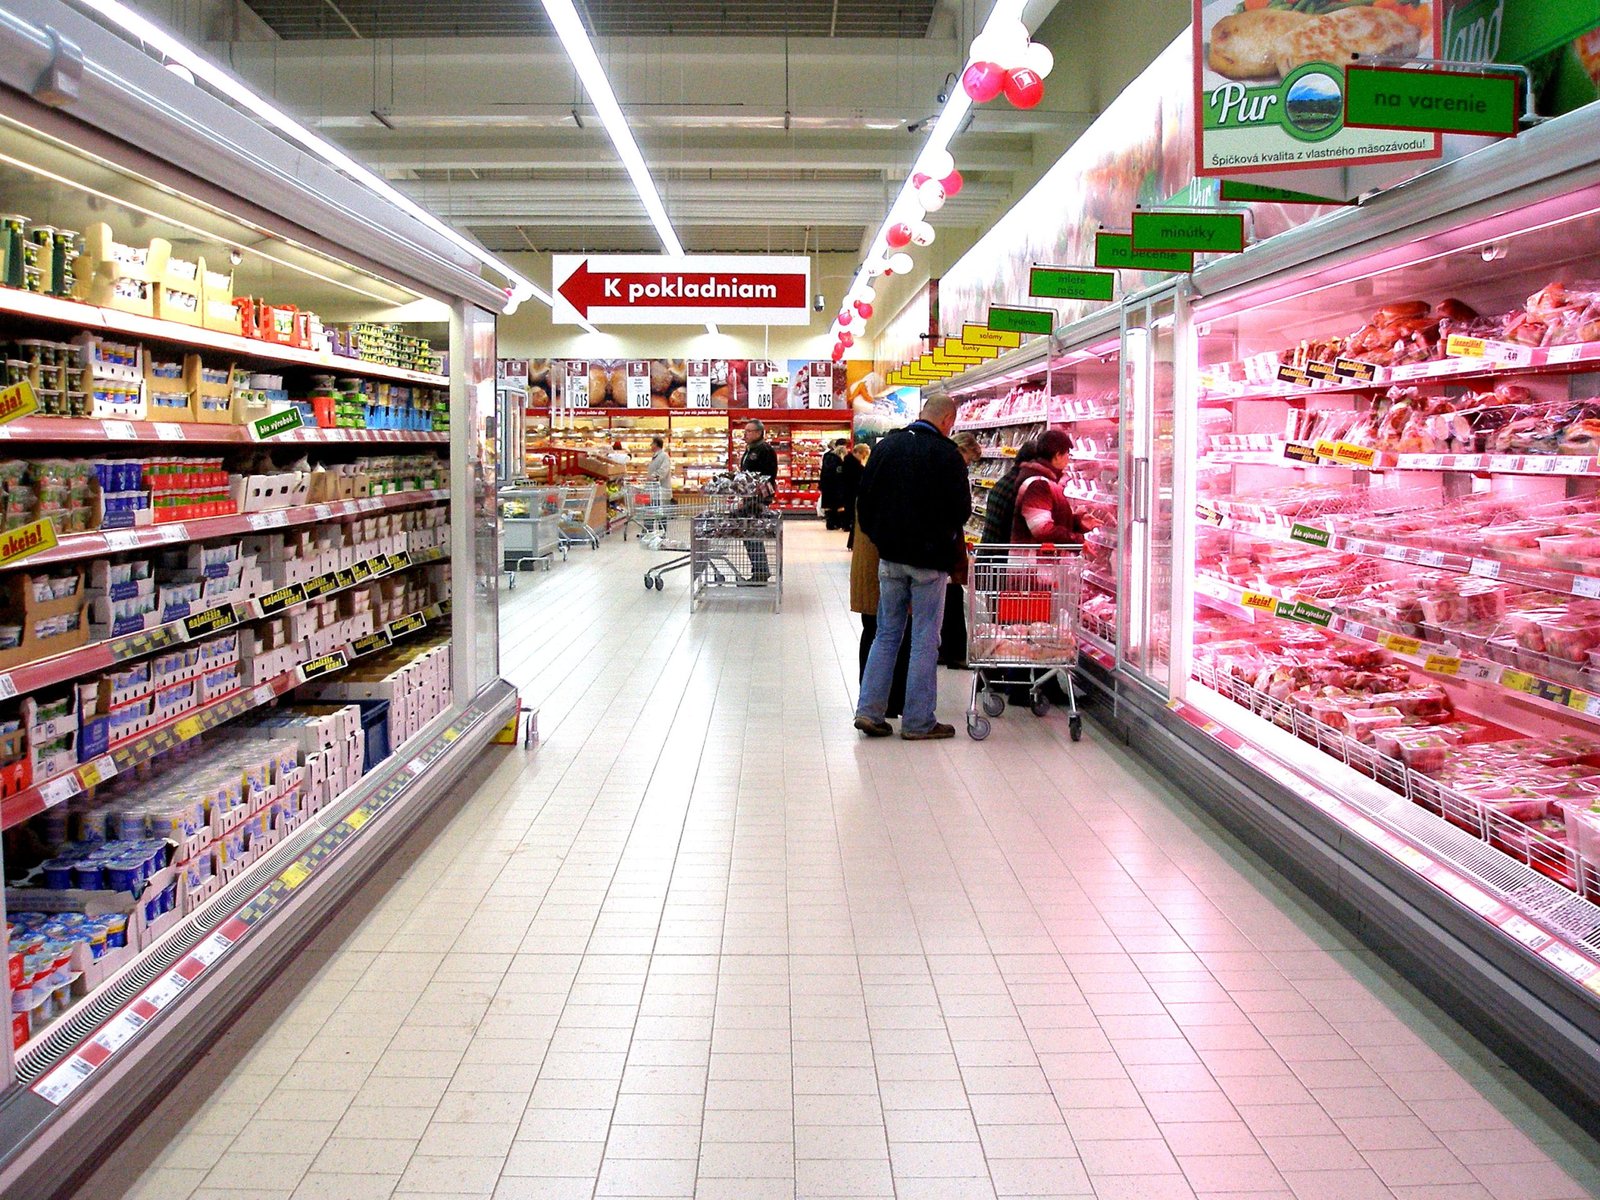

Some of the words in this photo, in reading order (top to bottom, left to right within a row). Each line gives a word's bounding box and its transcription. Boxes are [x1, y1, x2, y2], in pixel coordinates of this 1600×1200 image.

[1210, 82, 1277, 124] Pur
[1374, 92, 1401, 107] na
[1409, 94, 1487, 114] varenie
[1212, 151, 1259, 167] Špičková
[1261, 152, 1295, 163] kvalita
[1297, 151, 1303, 159] z
[1306, 146, 1355, 160] vlastného
[1357, 138, 1426, 154] mäsozávodu!
[1160, 225, 1216, 242] minútky
[604, 278, 622, 297] K
[628, 276, 777, 304] pokladniam
